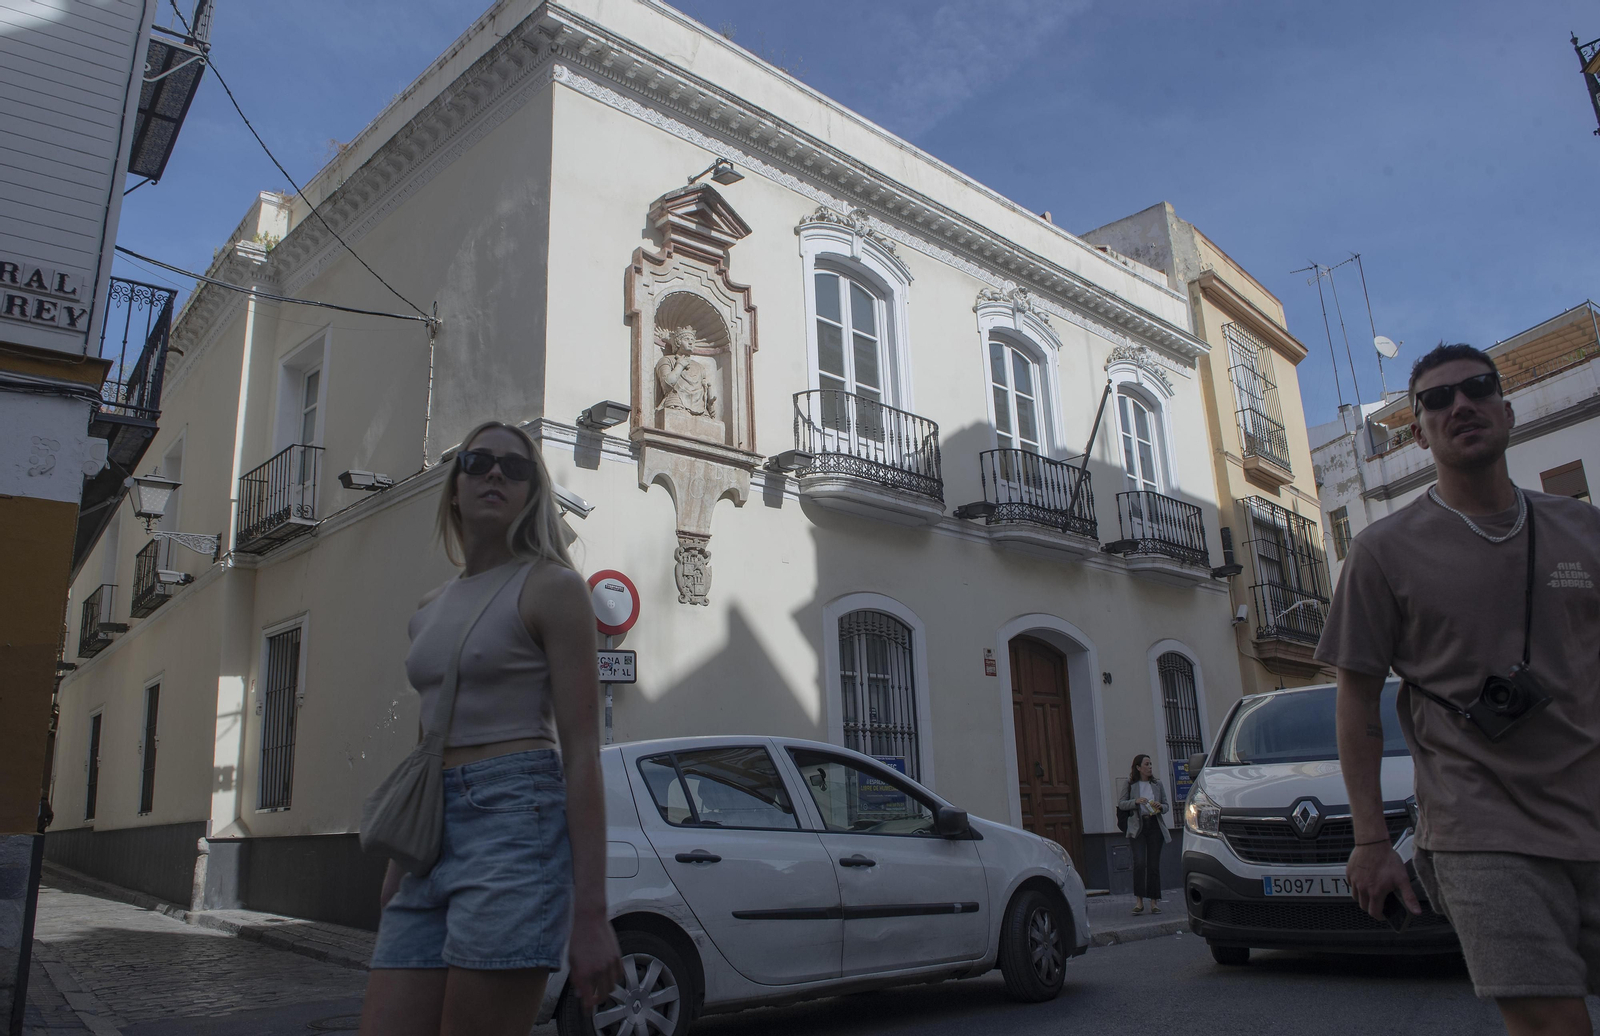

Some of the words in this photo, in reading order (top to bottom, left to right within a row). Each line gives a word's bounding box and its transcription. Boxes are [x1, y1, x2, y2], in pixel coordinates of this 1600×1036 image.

[0, 261, 77, 296] RAL
[3, 294, 88, 328] REY
[1102, 671, 1112, 685] 30
[1273, 878, 1314, 894] 5097
[1320, 878, 1351, 894] LTY
